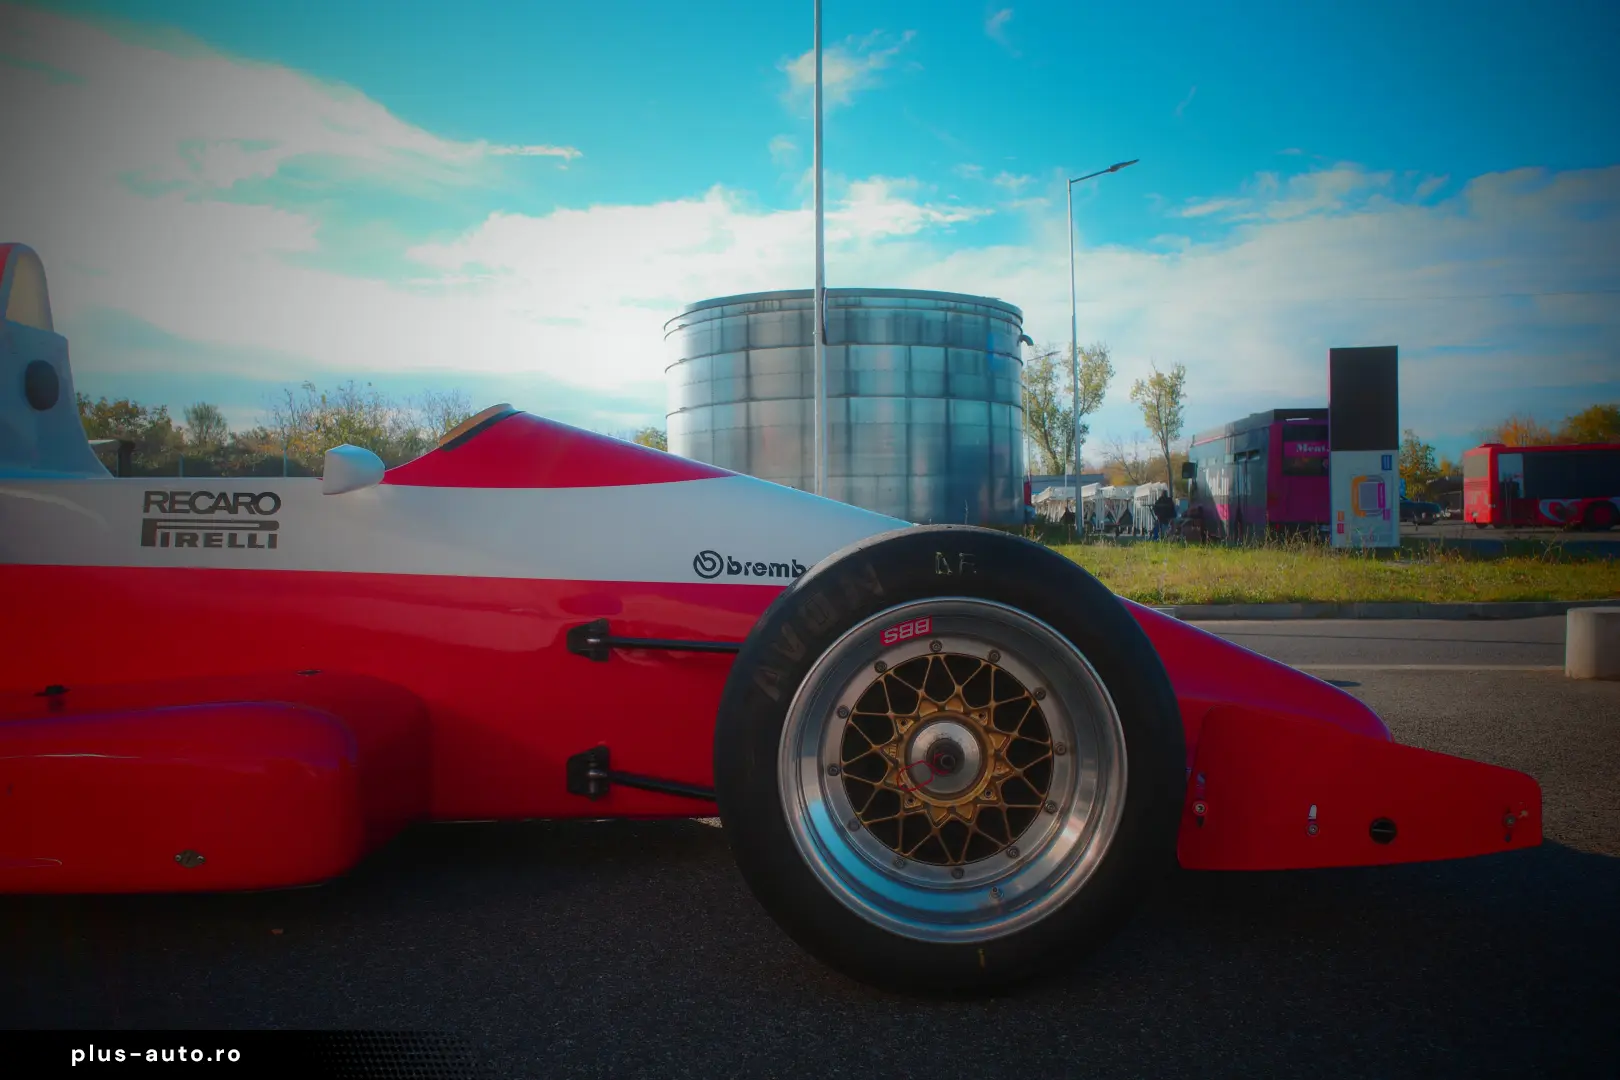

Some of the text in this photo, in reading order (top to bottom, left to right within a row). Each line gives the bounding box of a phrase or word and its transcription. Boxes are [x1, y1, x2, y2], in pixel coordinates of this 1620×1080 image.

[1296, 442, 1330, 453] Ment
[143, 490, 281, 515] RECARO
[141, 518, 280, 549] PIRELLI
[727, 555, 811, 579] bremb
[882, 617, 932, 646] BBS
